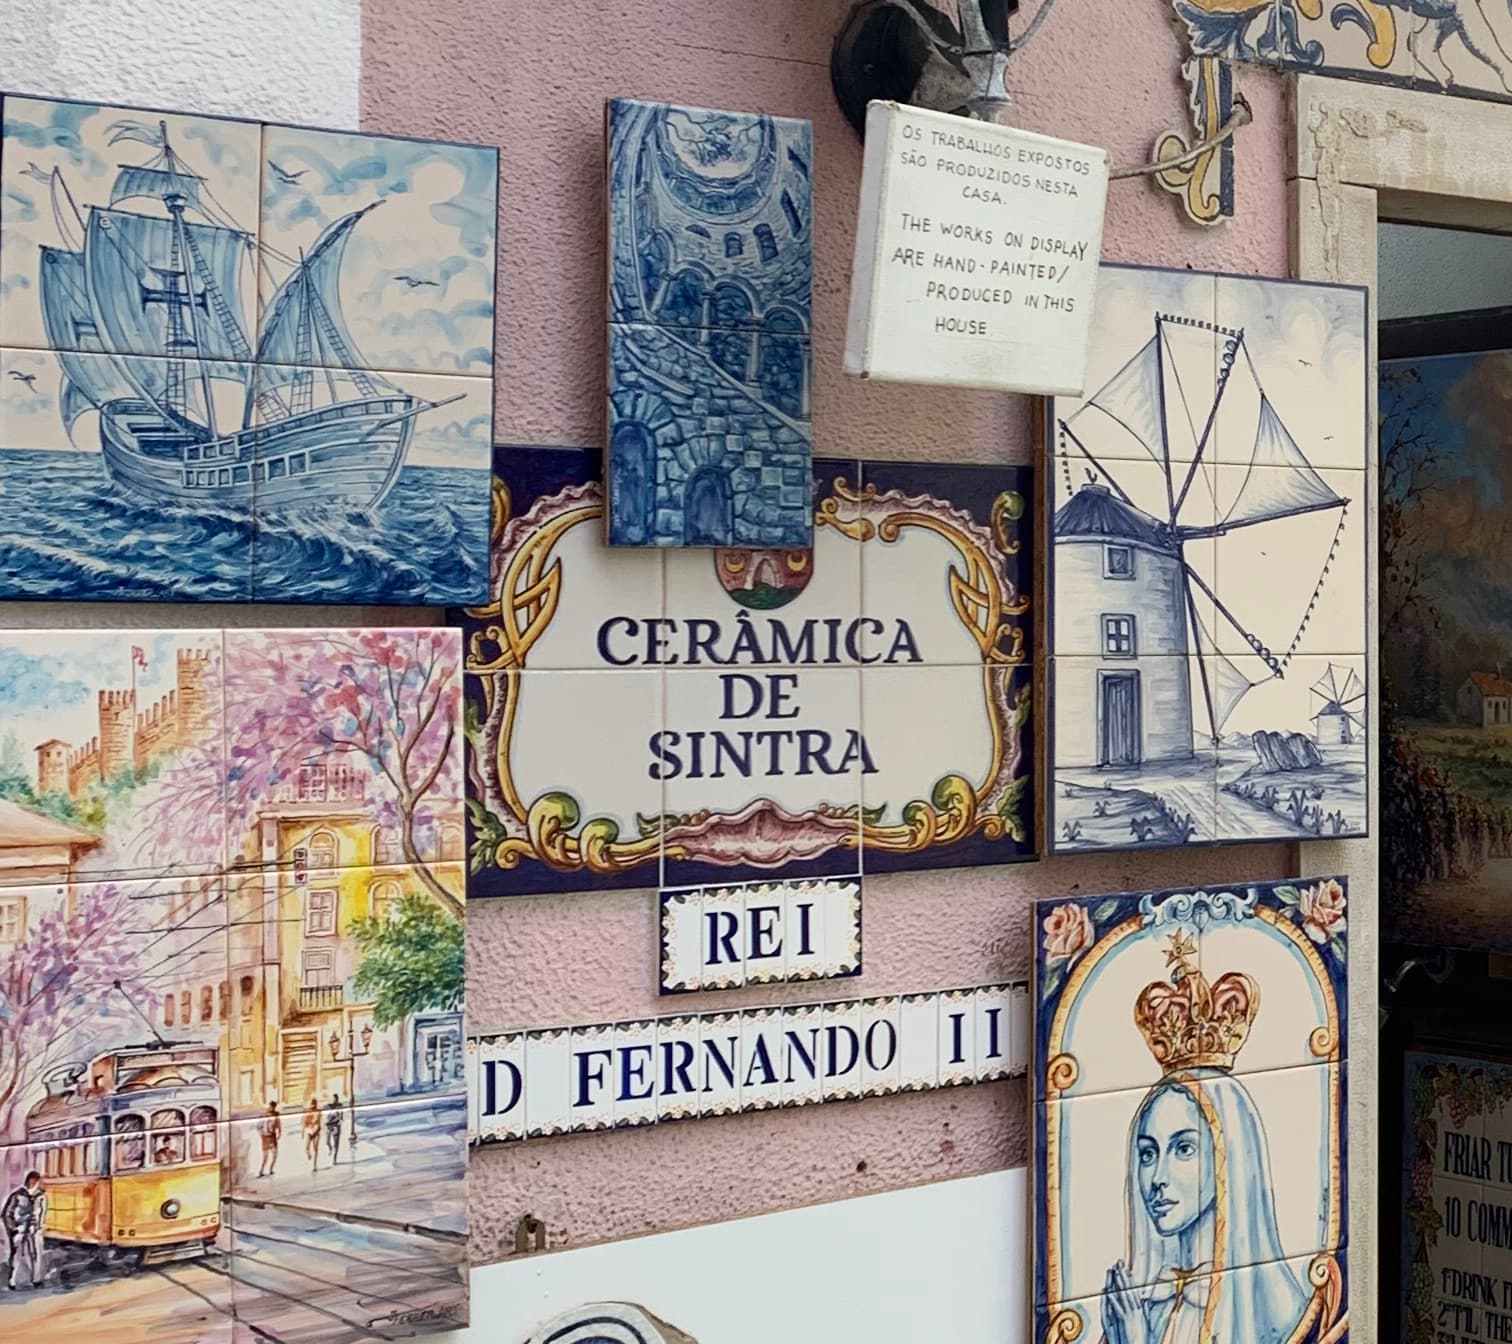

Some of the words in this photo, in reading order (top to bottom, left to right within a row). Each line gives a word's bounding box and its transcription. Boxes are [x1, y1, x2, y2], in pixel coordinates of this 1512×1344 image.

[900, 149, 928, 167] SÃO
[936, 159, 1031, 189] PRODUZIDOS
[1035, 179, 1078, 198] NESTA
[902, 124, 922, 141] OS
[931, 130, 1012, 159] TRABALHOS
[1018, 149, 1091, 176] EXPOSTOS
[962, 185, 1007, 206] CASA.
[891, 248, 924, 267] ARE
[901, 213, 931, 233] THE
[940, 221, 993, 245] WORKS
[1004, 233, 1023, 249] ON
[1031, 236, 1088, 263] DISPLAY
[926, 281, 1012, 305] PRODUCED
[1024, 295, 1039, 309] IN
[1044, 294, 1075, 312] THIS
[935, 317, 987, 336] HOUSE
[595, 609, 923, 667] CERÂMICA
[719, 673, 800, 721] DE
[647, 728, 879, 780] SINTRA
[704, 902, 816, 965] REI
[482, 1058, 523, 1117] D
[573, 1017, 898, 1107] FERNANDO
[946, 1007, 1003, 1065] II
[1443, 1131, 1491, 1180] FRIAR
[1445, 1196, 1461, 1237] 10
